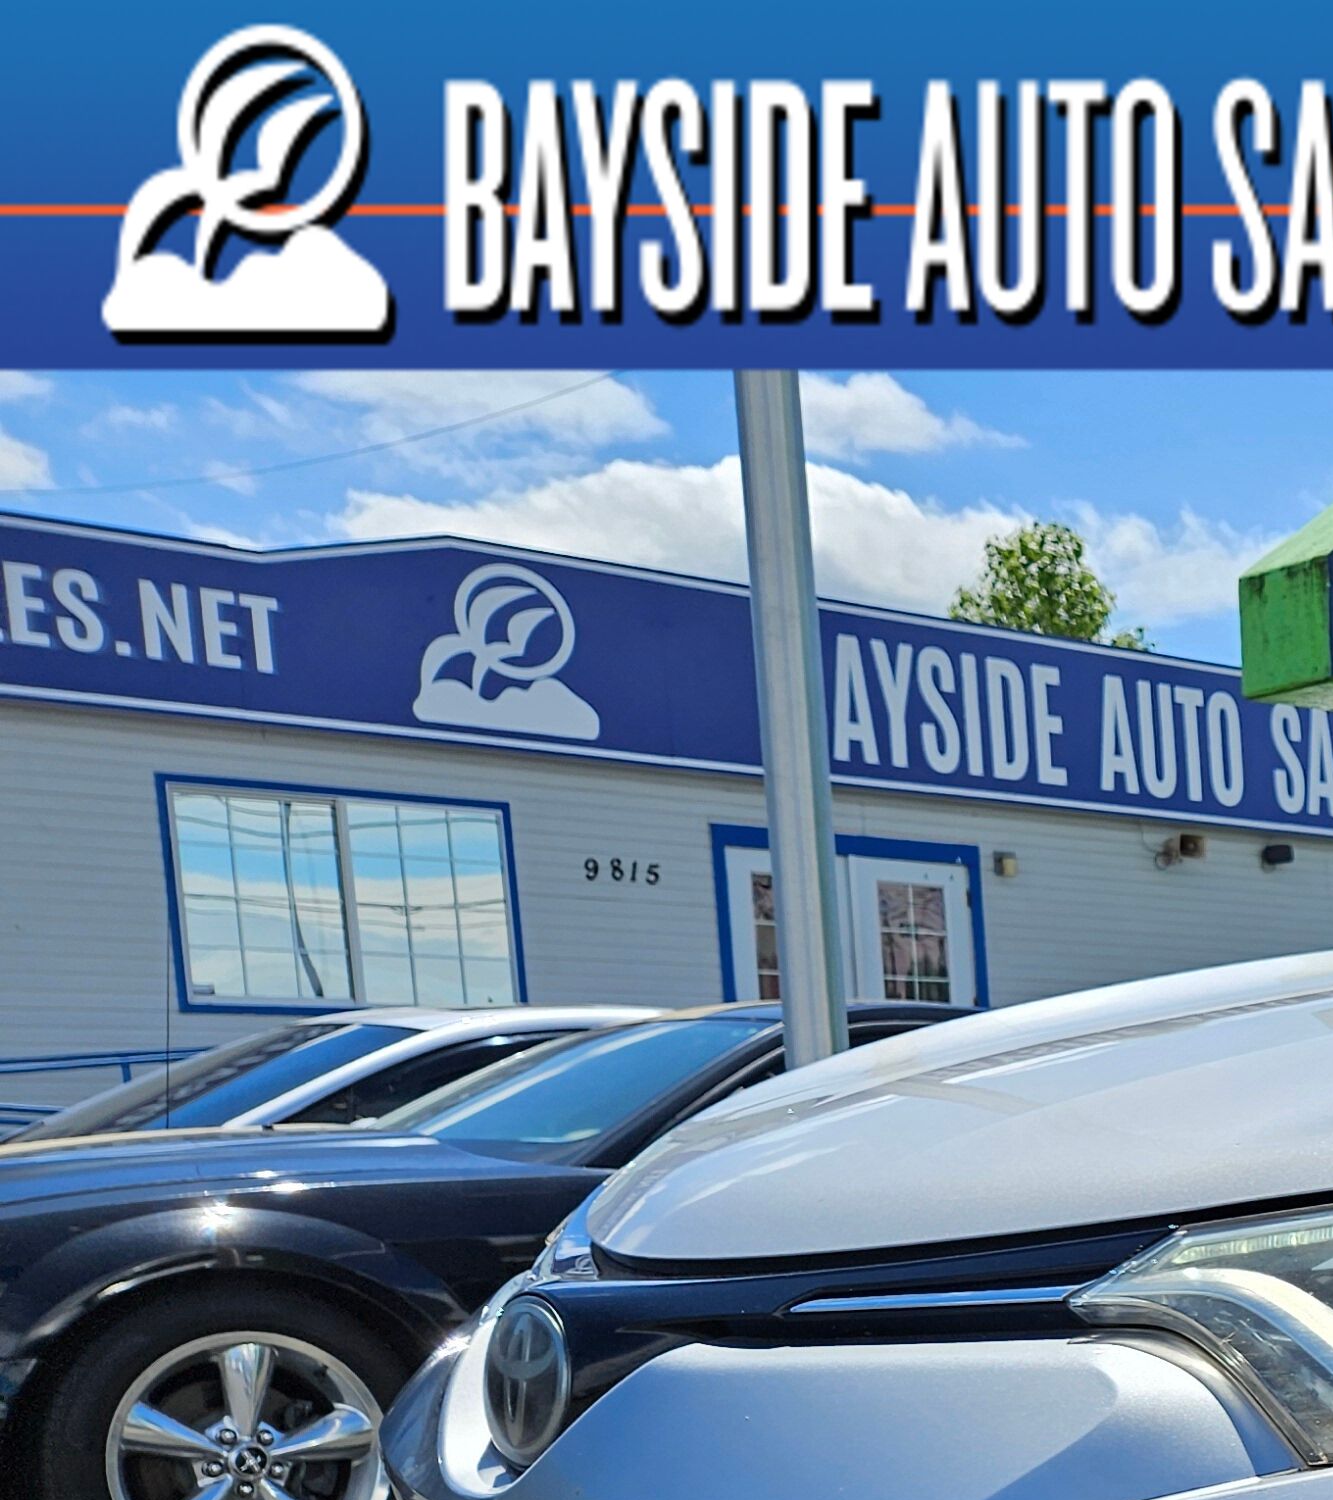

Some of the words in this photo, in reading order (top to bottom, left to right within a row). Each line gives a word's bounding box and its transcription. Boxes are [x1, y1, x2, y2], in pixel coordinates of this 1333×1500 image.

[0, 560, 279, 675] ES.NET
[833, 633, 1068, 787] AYSIDE
[1101, 674, 1244, 808] AUTO
[584, 858, 660, 886] 9815
